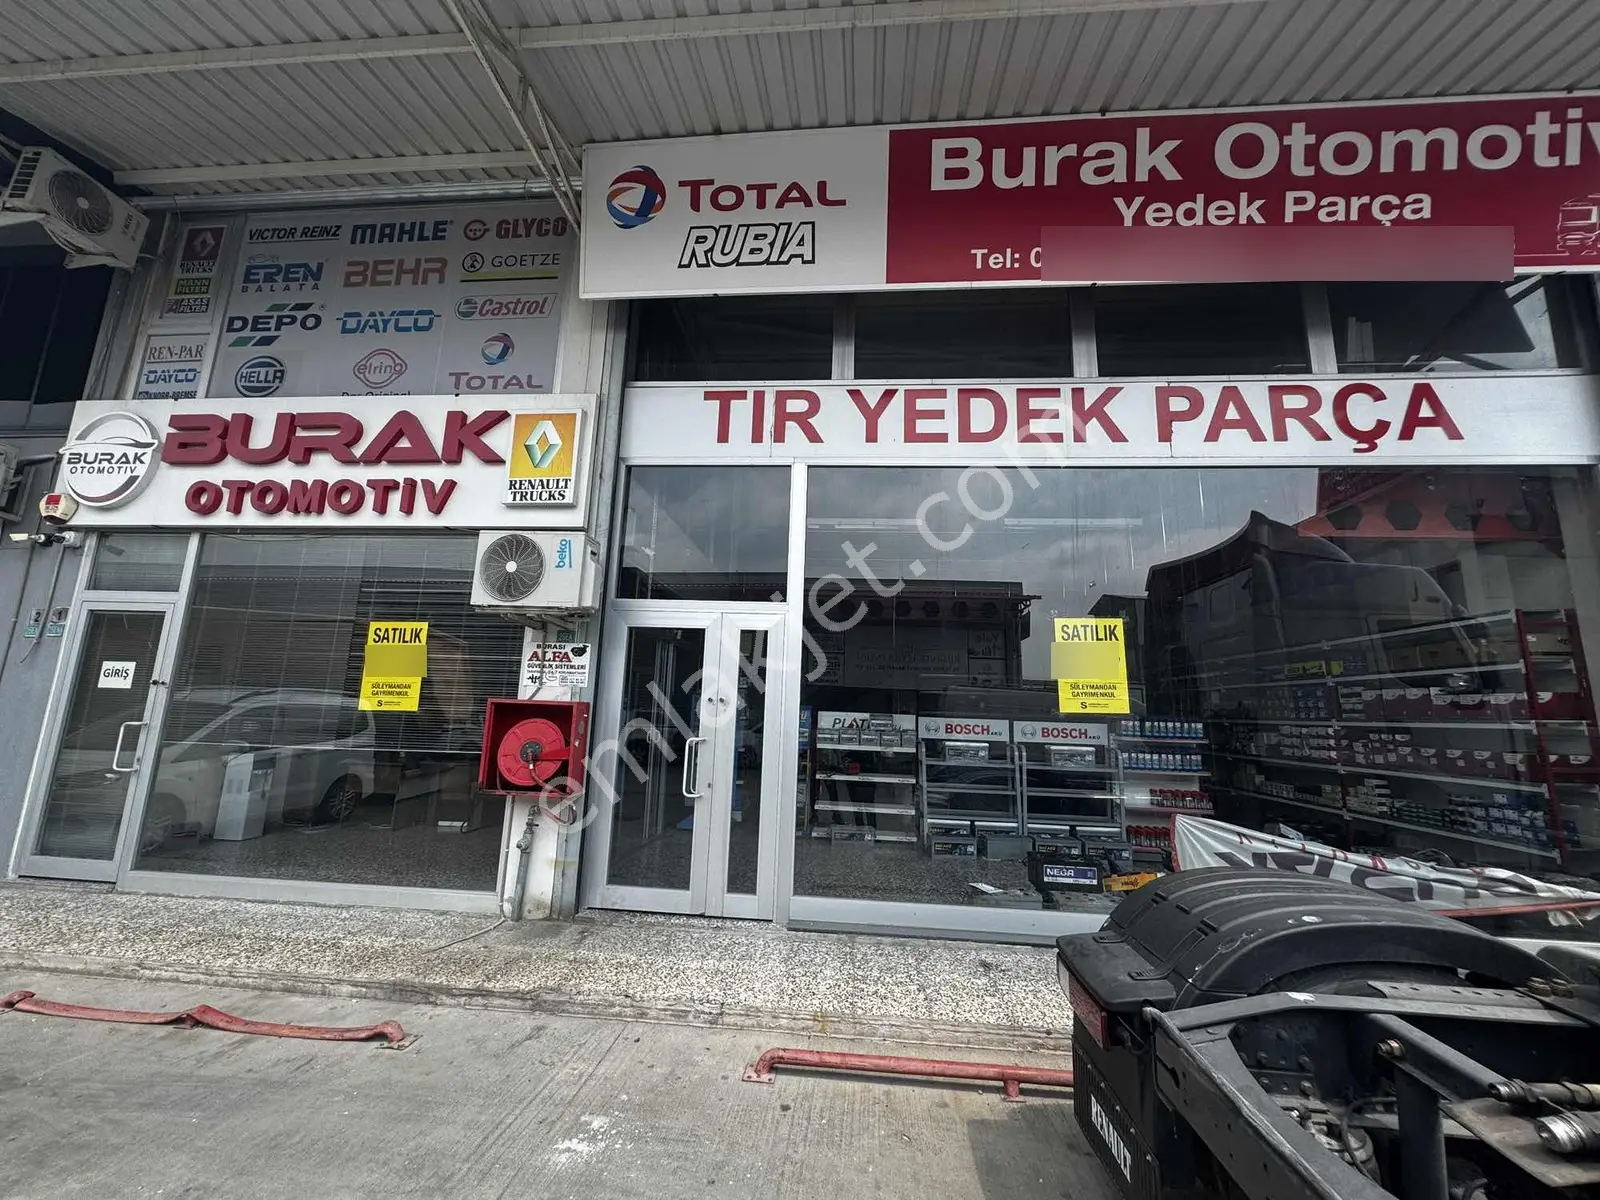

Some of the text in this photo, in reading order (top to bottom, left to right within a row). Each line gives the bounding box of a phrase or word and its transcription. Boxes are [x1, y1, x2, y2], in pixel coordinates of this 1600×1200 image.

[929, 126, 1185, 191] Burak
[677, 178, 847, 213] TOTAL
[1112, 189, 1433, 227] Yedek Parça
[249, 224, 342, 241] VICTOR REINZ
[350, 219, 449, 244] MAHLE
[495, 216, 568, 240] GLYCO
[677, 220, 816, 269] RUBIA
[491, 253, 561, 268] GOETZE
[970, 247, 1020, 270] Tel:
[242, 261, 325, 284] EREN
[342, 256, 449, 289] BEHR
[241, 283, 320, 293] BALATA
[178, 305, 207, 313] FILTER
[478, 296, 547, 318] Castrol
[225, 313, 322, 334] DEPO
[339, 308, 436, 335] DAYCO
[147, 344, 204, 361] REN-PAR
[144, 367, 198, 384] DAYCO
[239, 368, 286, 385] HELLA
[356, 361, 404, 377] elring
[448, 371, 544, 391] TOTAL
[703, 381, 1466, 454] TIR YEDEK PARÇA
[161, 410, 512, 466] BURAK
[66, 452, 148, 465] BURAK
[508, 477, 572, 490] RENAULT
[510, 489, 566, 502] TRUCKS
[554, 538, 568, 569] beko
[34, 611, 42, 623] 2
[56, 610, 63, 621] 1
[372, 627, 424, 644] SATILIK
[1060, 624, 1120, 642] SATILIK
[527, 650, 573, 663] ALFA
[103, 666, 130, 680] GİRİŞ
[370, 682, 412, 690] SÜLEYMANDAN
[1069, 683, 1117, 691] SÜLEYMANDAN
[944, 723, 990, 736] BOSCH
[1041, 726, 1088, 740] BOSCH
[1046, 867, 1075, 877] NEGA
[1091, 1093, 1132, 1184] RENAULT
